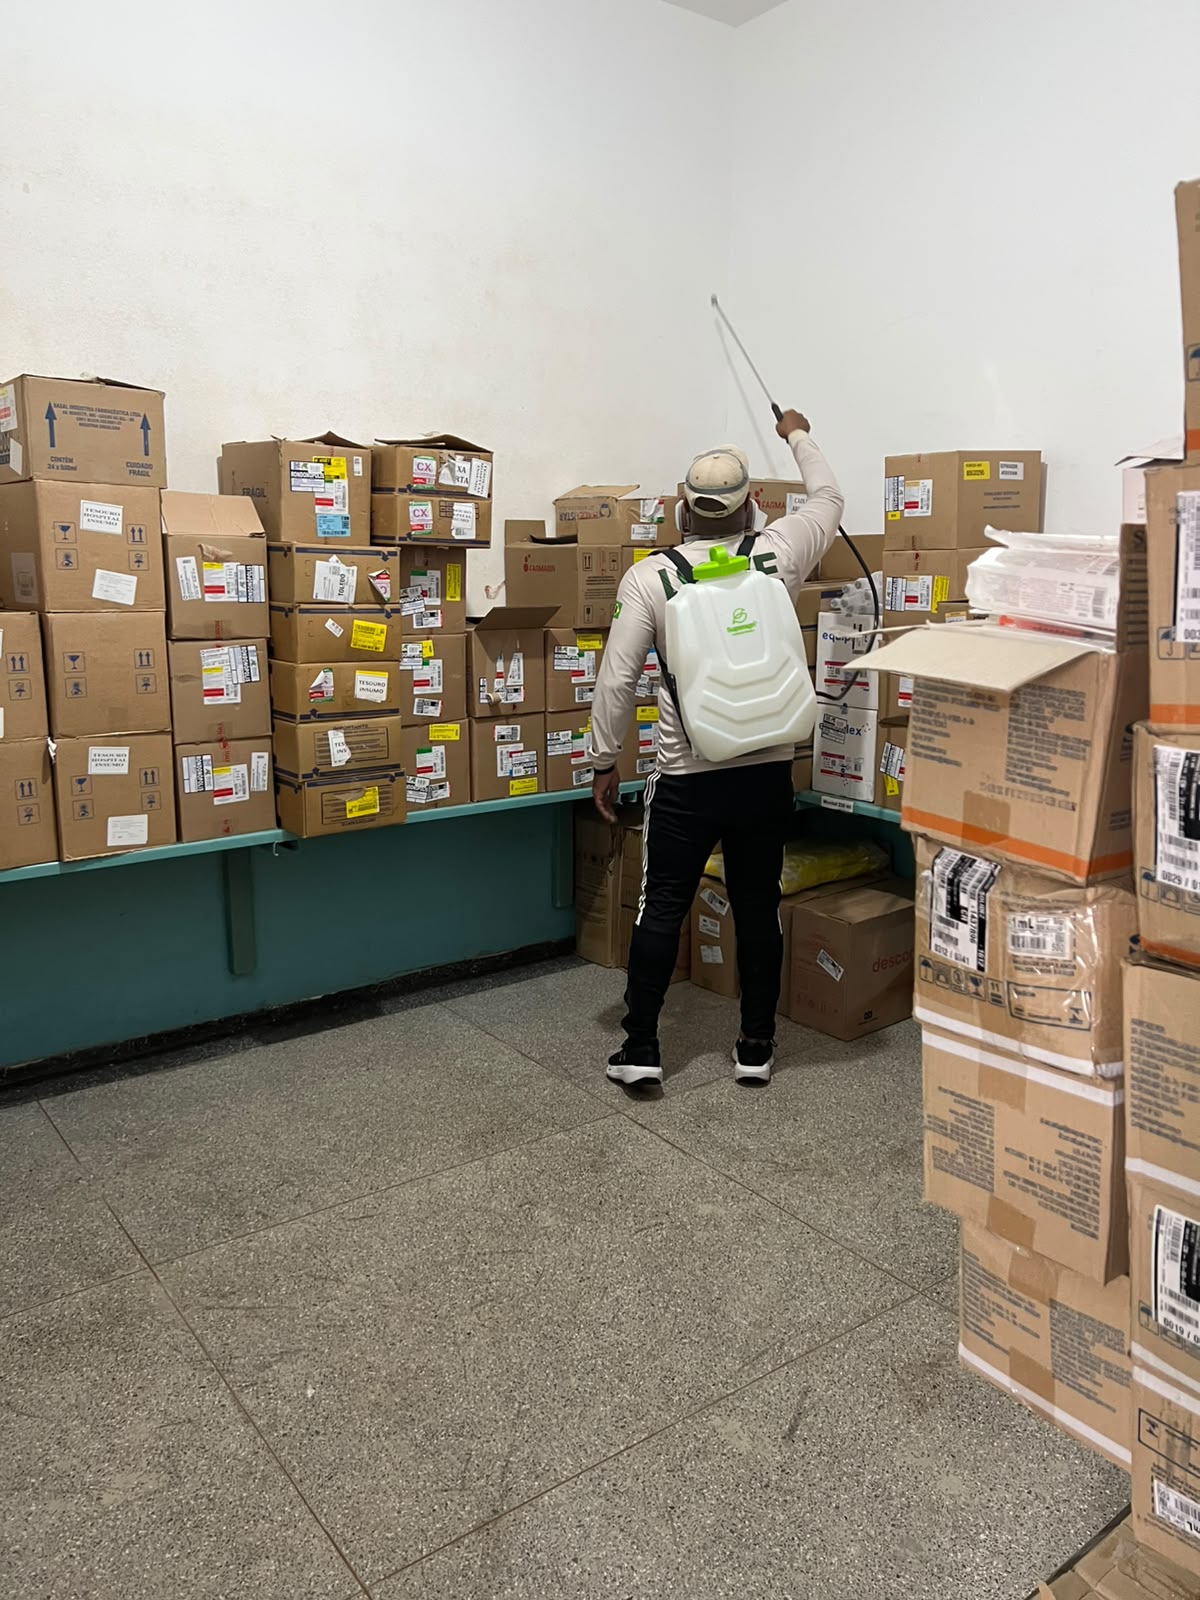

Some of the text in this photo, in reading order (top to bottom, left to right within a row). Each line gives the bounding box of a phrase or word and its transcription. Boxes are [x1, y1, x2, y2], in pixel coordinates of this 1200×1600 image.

[416, 462, 432, 472] CX
[412, 508, 428, 518] CX
[338, 573, 346, 597] TOLEDO
[358, 679, 386, 687] TESOURO
